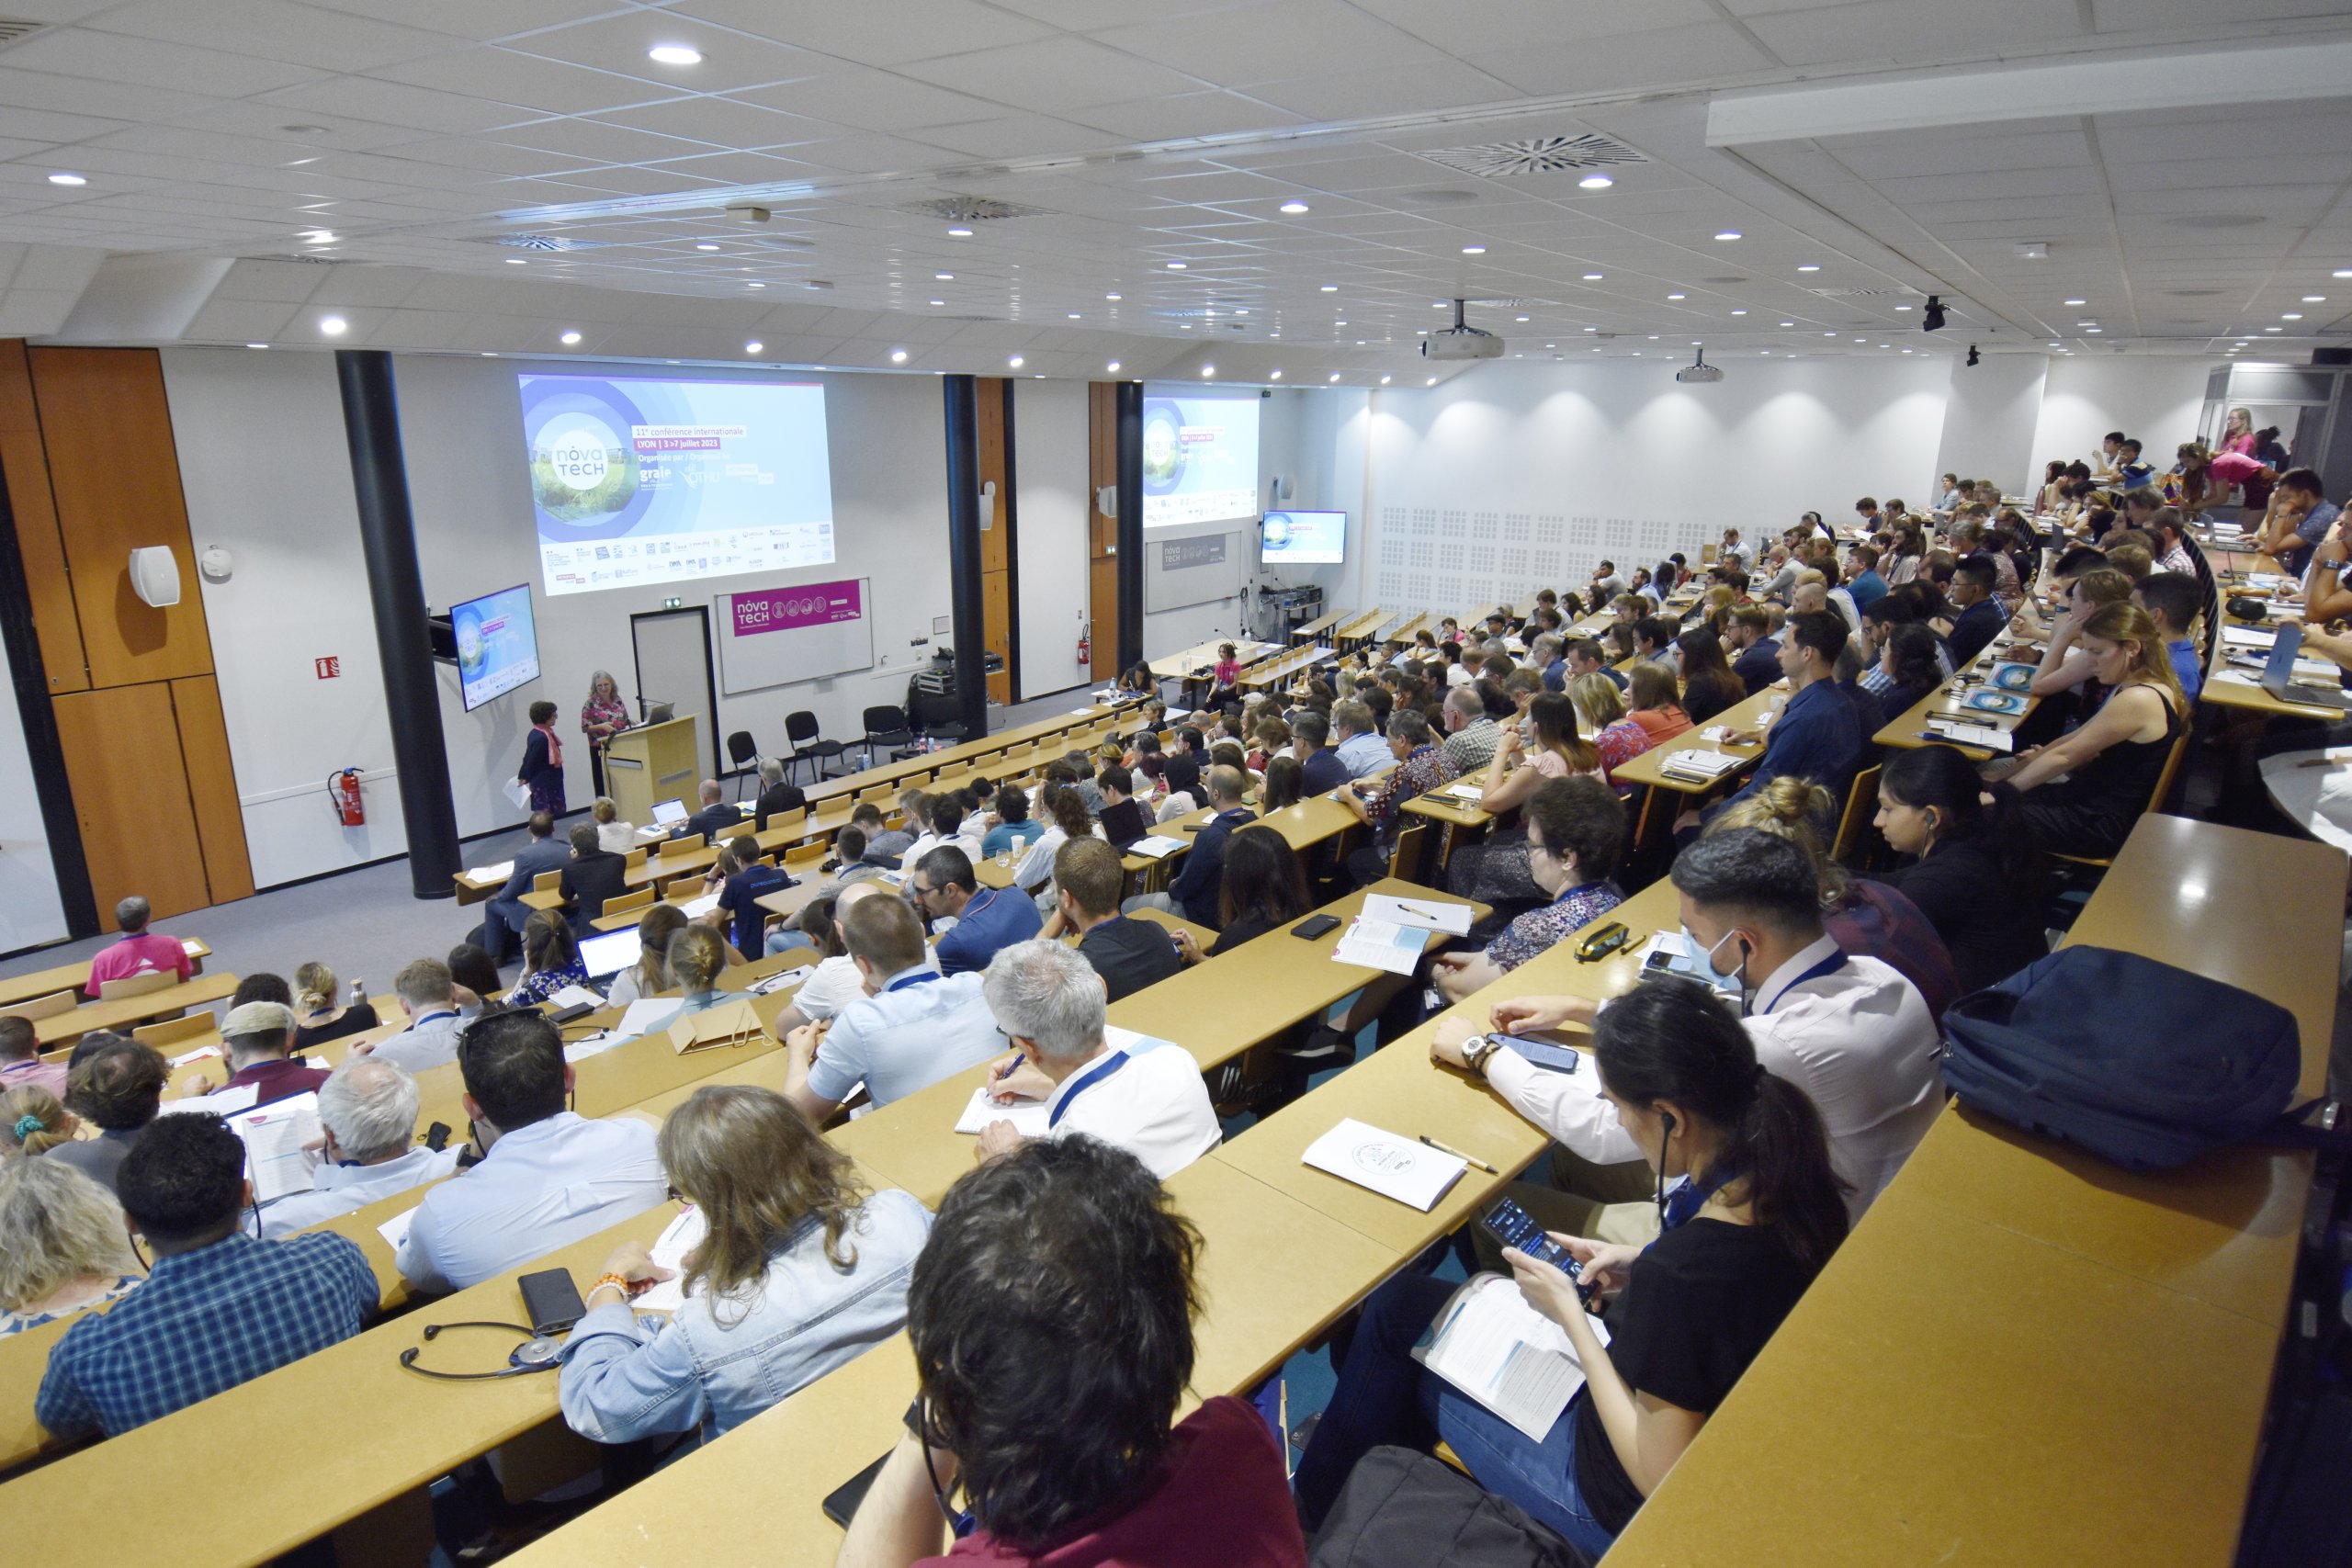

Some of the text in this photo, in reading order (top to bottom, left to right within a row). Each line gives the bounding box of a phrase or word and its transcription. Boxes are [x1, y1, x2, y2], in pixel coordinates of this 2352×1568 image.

[650, 426, 693, 436] conférence
[694, 426, 744, 435] internationale
[638, 440, 657, 449] LYON
[680, 439, 700, 449] juillet
[701, 439, 718, 447] 2023
[639, 466, 672, 482] graie
